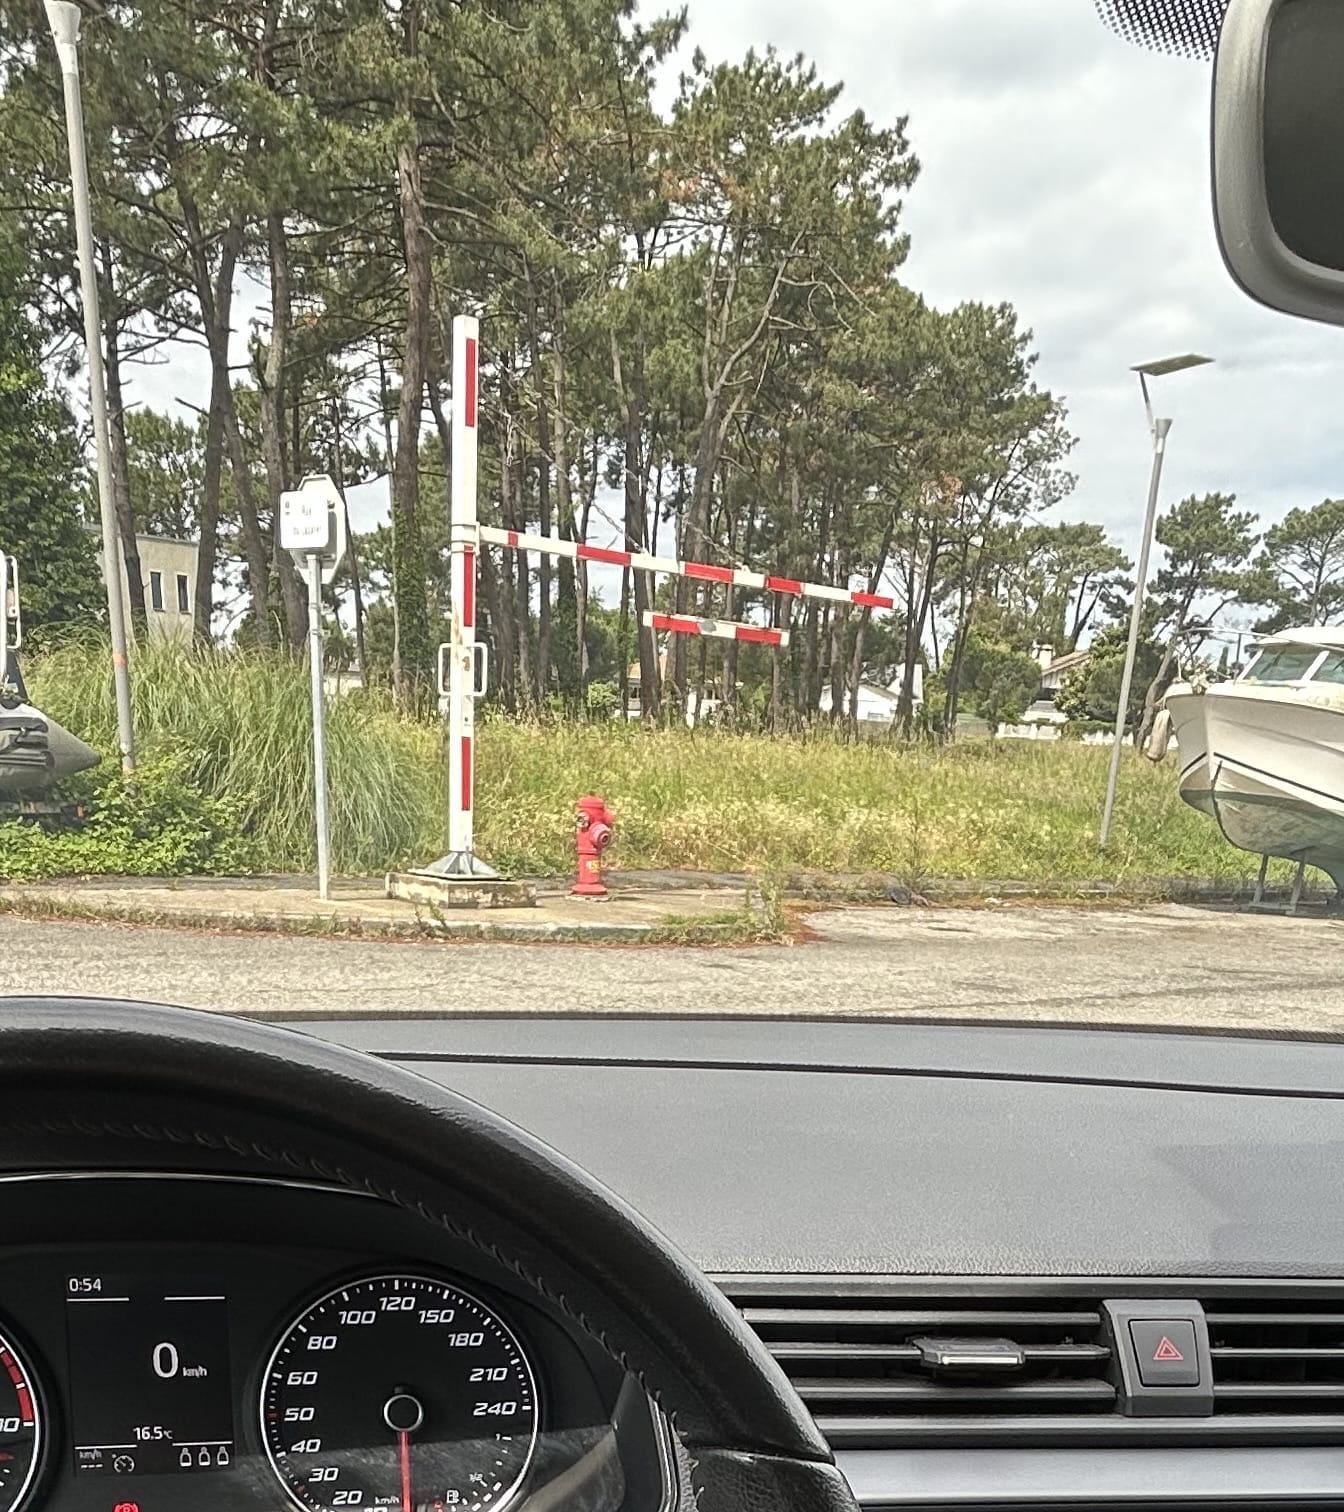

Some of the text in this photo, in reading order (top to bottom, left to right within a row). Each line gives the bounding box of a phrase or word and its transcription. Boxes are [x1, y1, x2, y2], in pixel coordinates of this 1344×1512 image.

[69, 1278, 102, 1292] 0:54
[379, 1297, 415, 1310] 120
[338, 1311, 376, 1324] 100
[417, 1310, 455, 1323] 150
[307, 1336, 337, 1349] 80
[448, 1333, 484, 1346] 180
[153, 1342, 207, 1378] 0 km/h
[287, 1372, 318, 1385] 60
[469, 1368, 507, 1381] 210
[284, 1408, 314, 1421] 50
[473, 1402, 517, 1416] 240
[291, 1439, 321, 1452] 40
[308, 1468, 338, 1481] 30
[332, 1491, 362, 1505] 20
